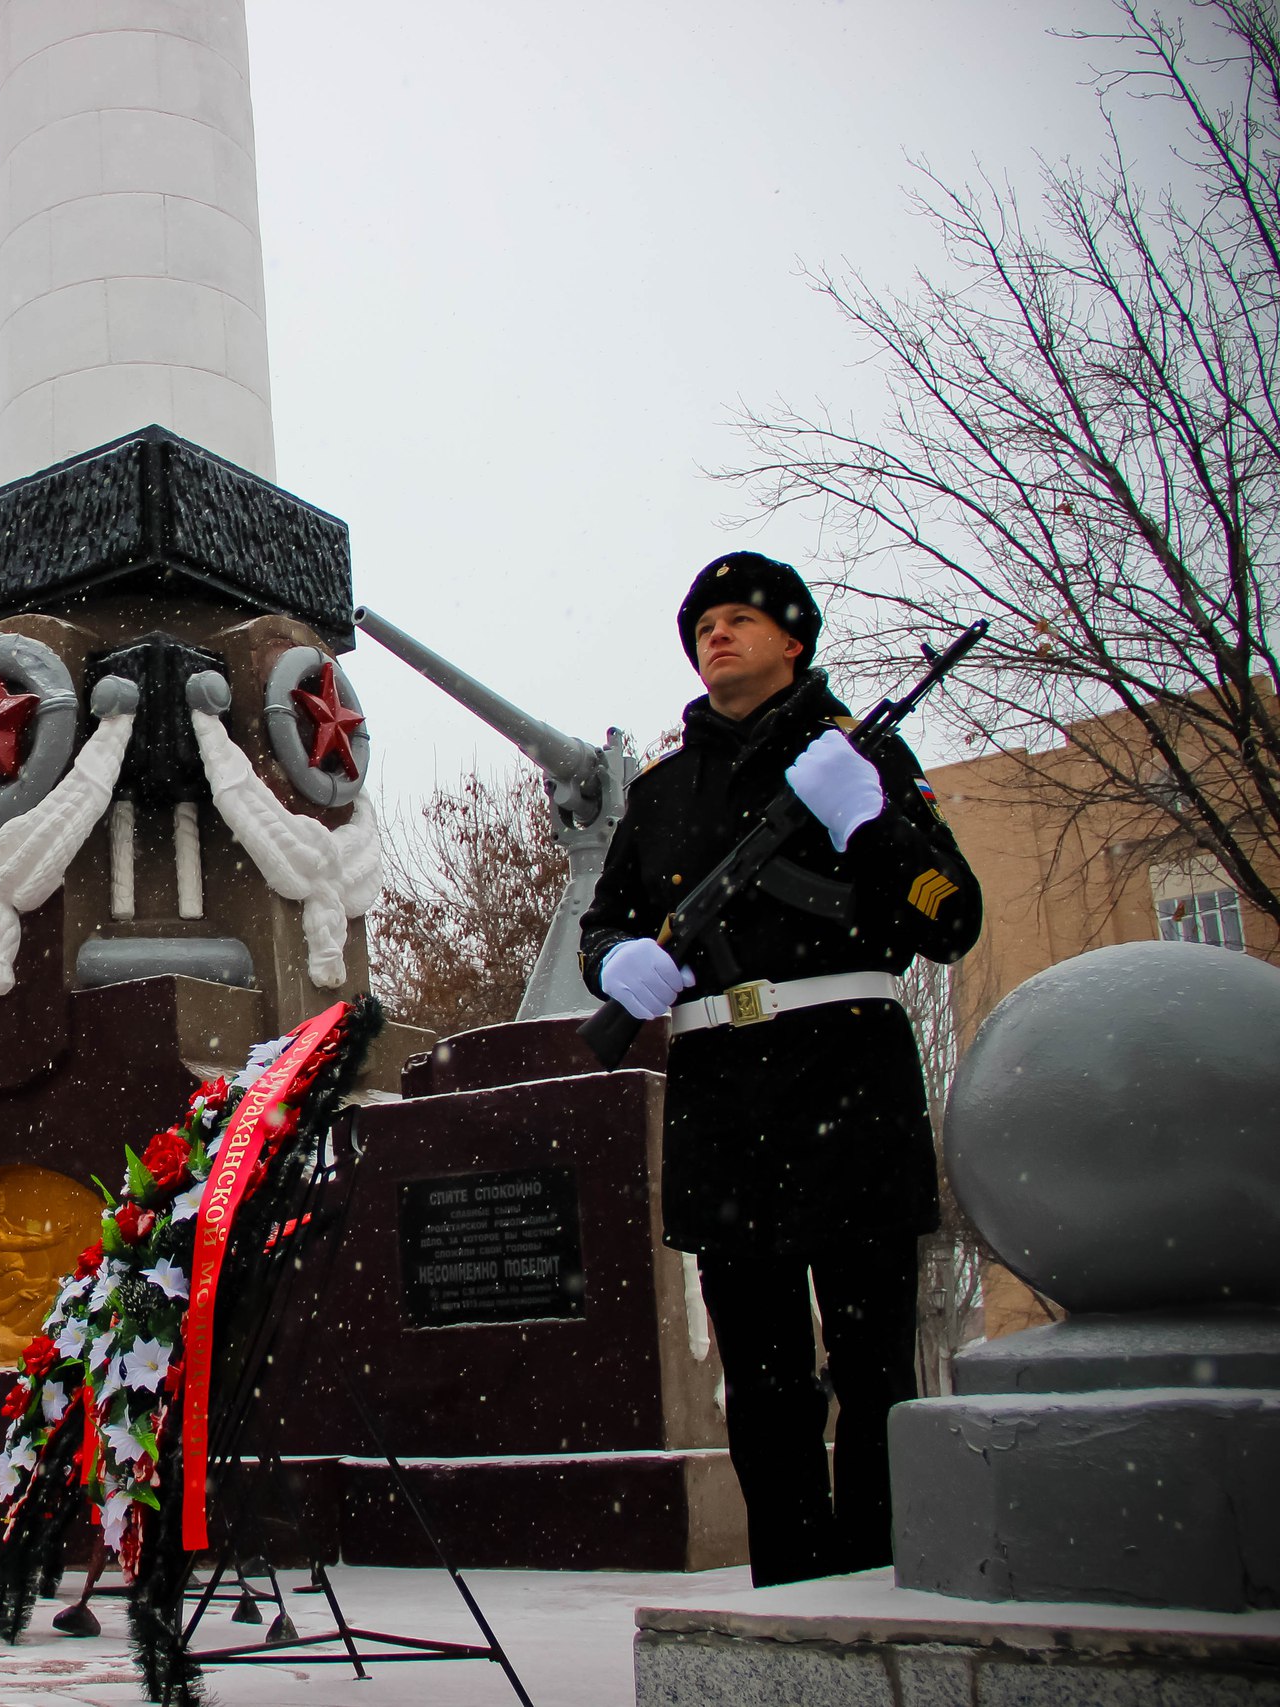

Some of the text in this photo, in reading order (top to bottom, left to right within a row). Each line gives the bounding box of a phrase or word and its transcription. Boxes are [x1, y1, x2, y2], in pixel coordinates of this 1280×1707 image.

[429, 1181, 542, 1206] СПИТЕ СПОКОЙНО
[418, 1255, 560, 1284] НЕСОМНЕННО ПОБЕДИТ
